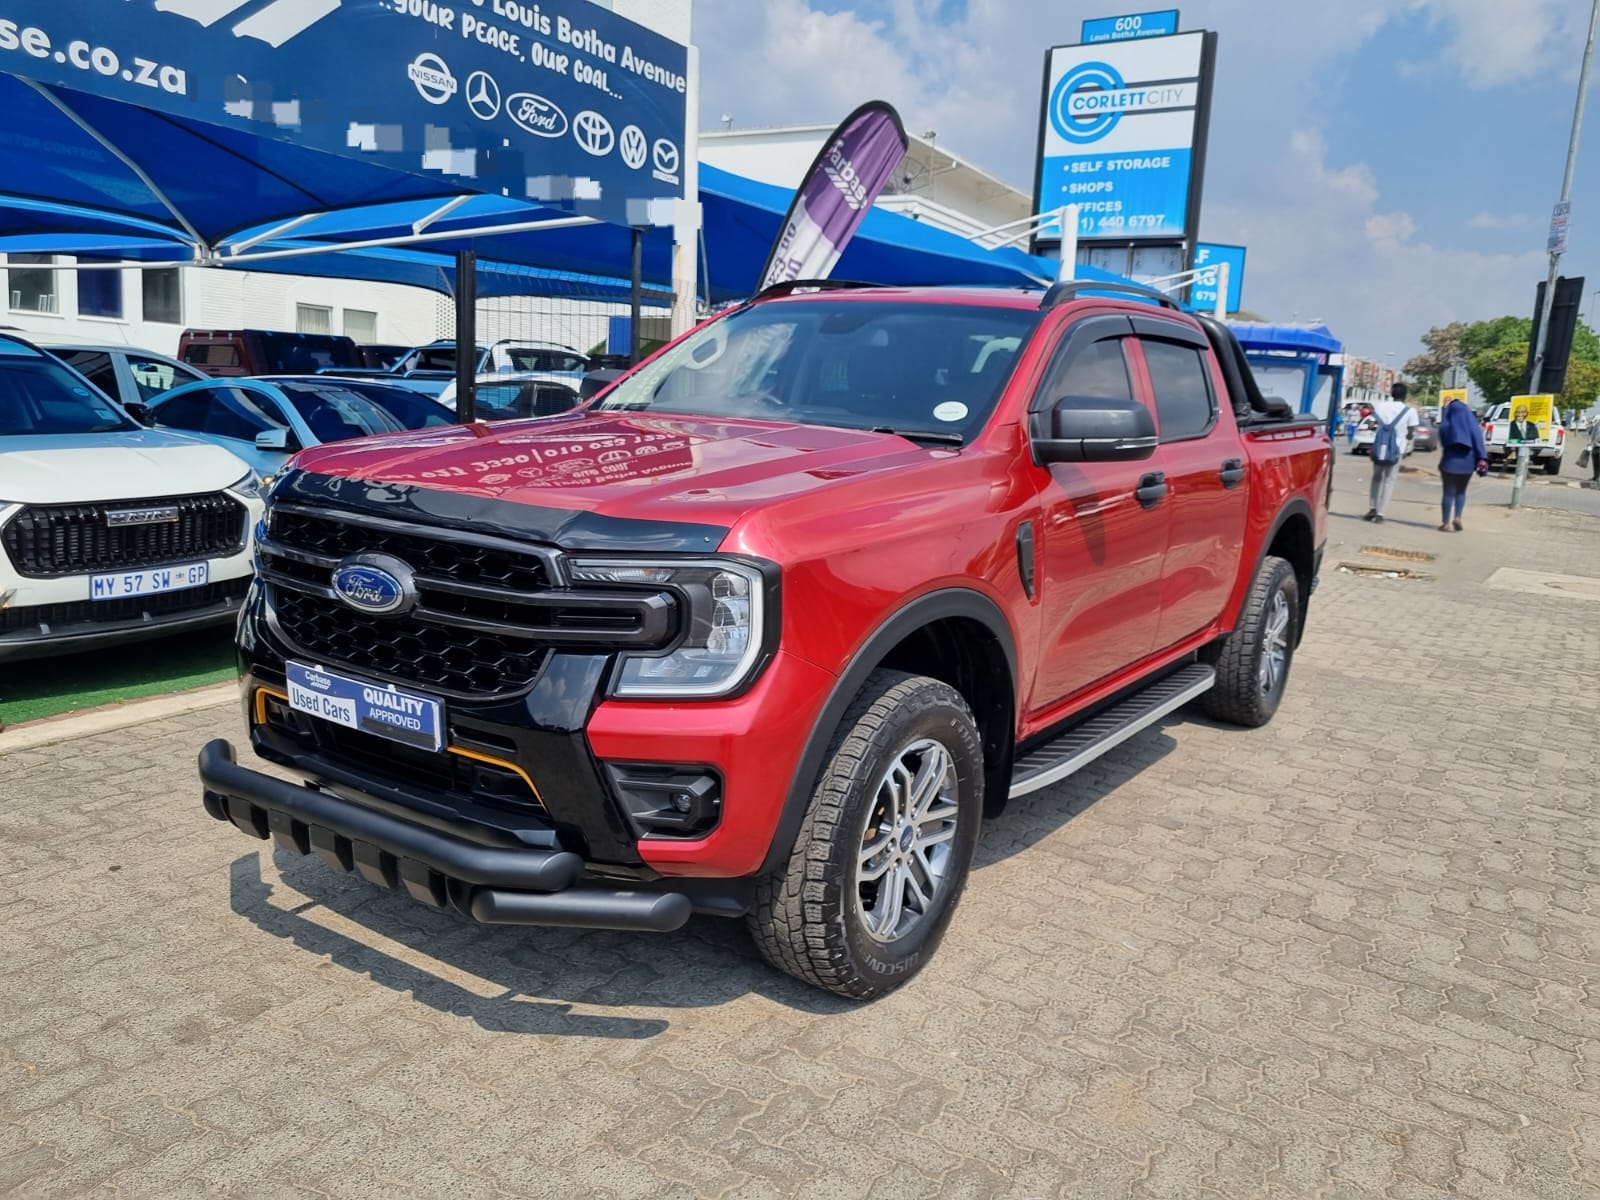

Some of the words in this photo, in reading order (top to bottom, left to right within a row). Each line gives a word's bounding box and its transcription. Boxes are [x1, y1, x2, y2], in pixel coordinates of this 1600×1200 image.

[1111, 30, 1135, 40] Botha
[1115, 16, 1142, 32] 600
[462, 12, 526, 62] PEACE,
[531, 42, 569, 75] OUR
[557, 16, 616, 63] Botha
[620, 46, 686, 93] Avenue
[410, 67, 456, 90] NISSAN
[517, 98, 558, 131] Ford
[1071, 161, 1104, 174] SELF
[1106, 156, 1171, 171] STORAGE
[1068, 181, 1114, 194] SHOPS
[1076, 200, 1123, 213] FFICES
[1098, 215, 1125, 228] 440
[1128, 213, 1166, 228] 6797
[94, 577, 115, 597] MY
[124, 574, 143, 593] 57
[152, 571, 171, 589] SW
[188, 565, 205, 584] GP
[345, 573, 384, 603] Ford
[304, 670, 332, 687] Carbase
[292, 687, 320, 718] Used
[323, 698, 351, 722] Cars
[363, 688, 424, 716] QUALITY
[369, 707, 421, 730] APPROVED
